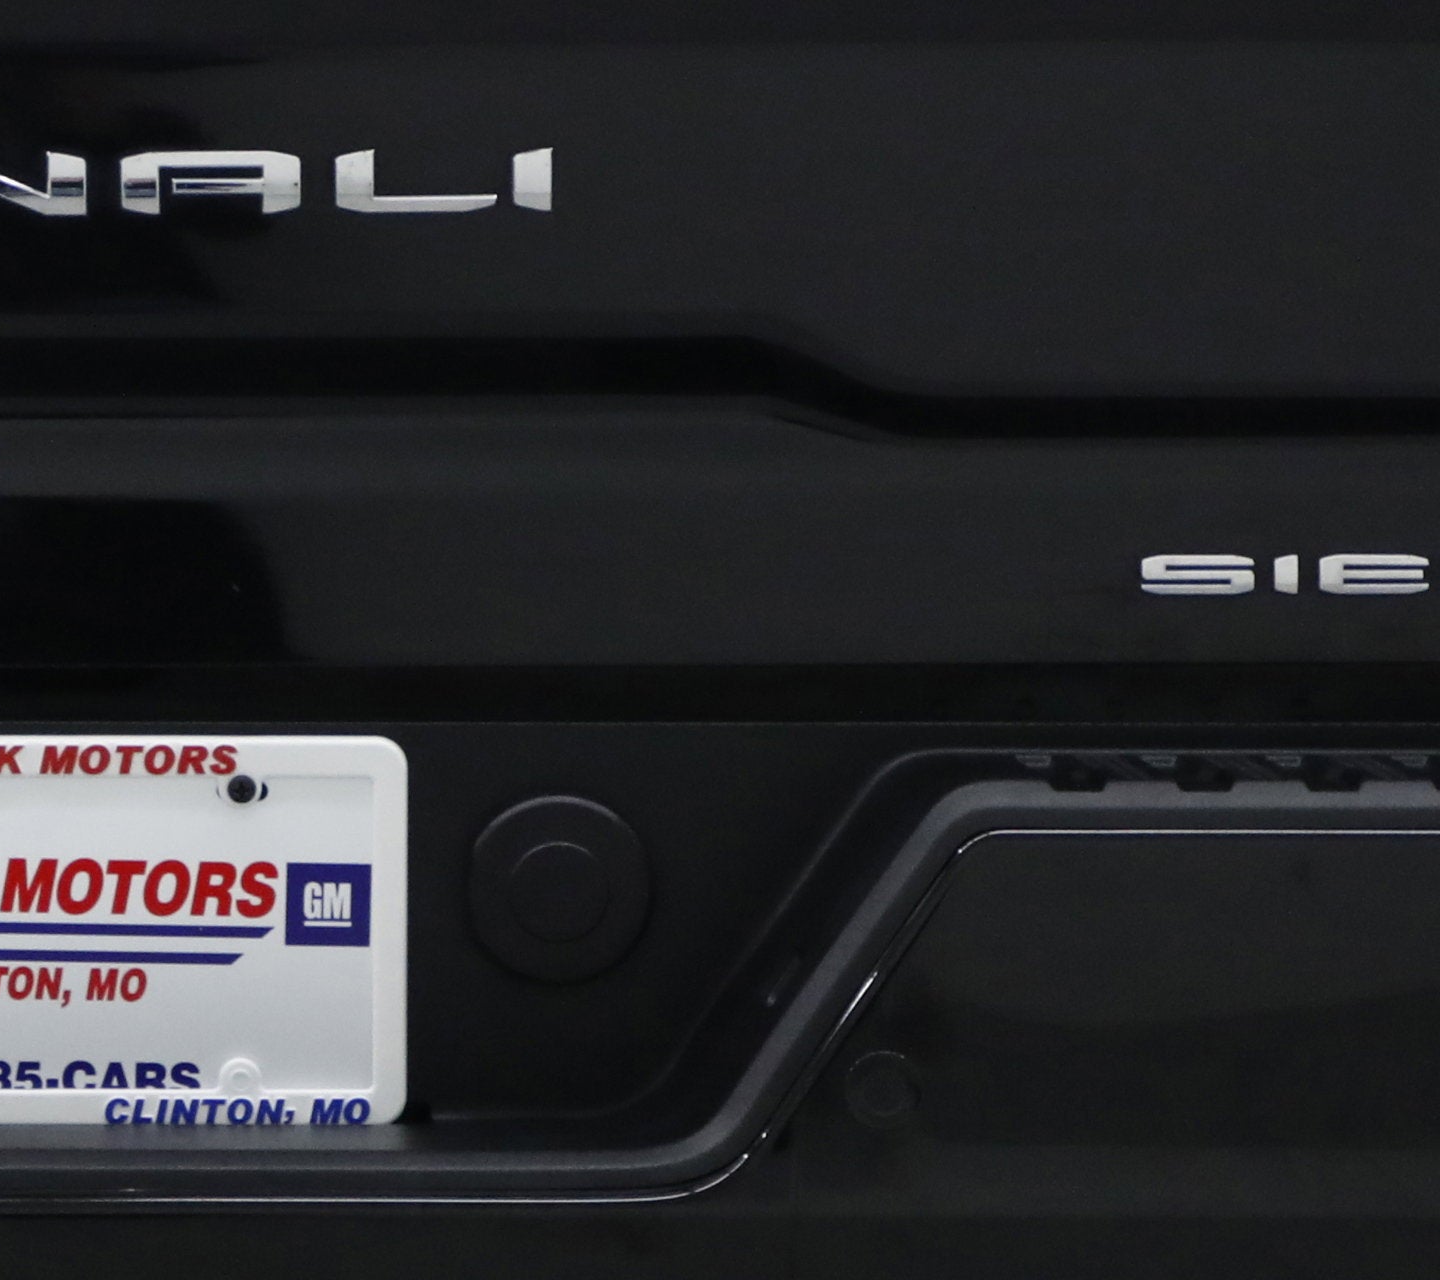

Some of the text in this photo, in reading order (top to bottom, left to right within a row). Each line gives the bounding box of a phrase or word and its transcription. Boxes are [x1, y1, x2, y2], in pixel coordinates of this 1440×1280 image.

[38, 745, 239, 775] MOTORS
[0, 858, 279, 918] MOTORS
[302, 881, 353, 921] GM
[84, 968, 148, 1003] MO
[309, 1098, 371, 1124] MO
